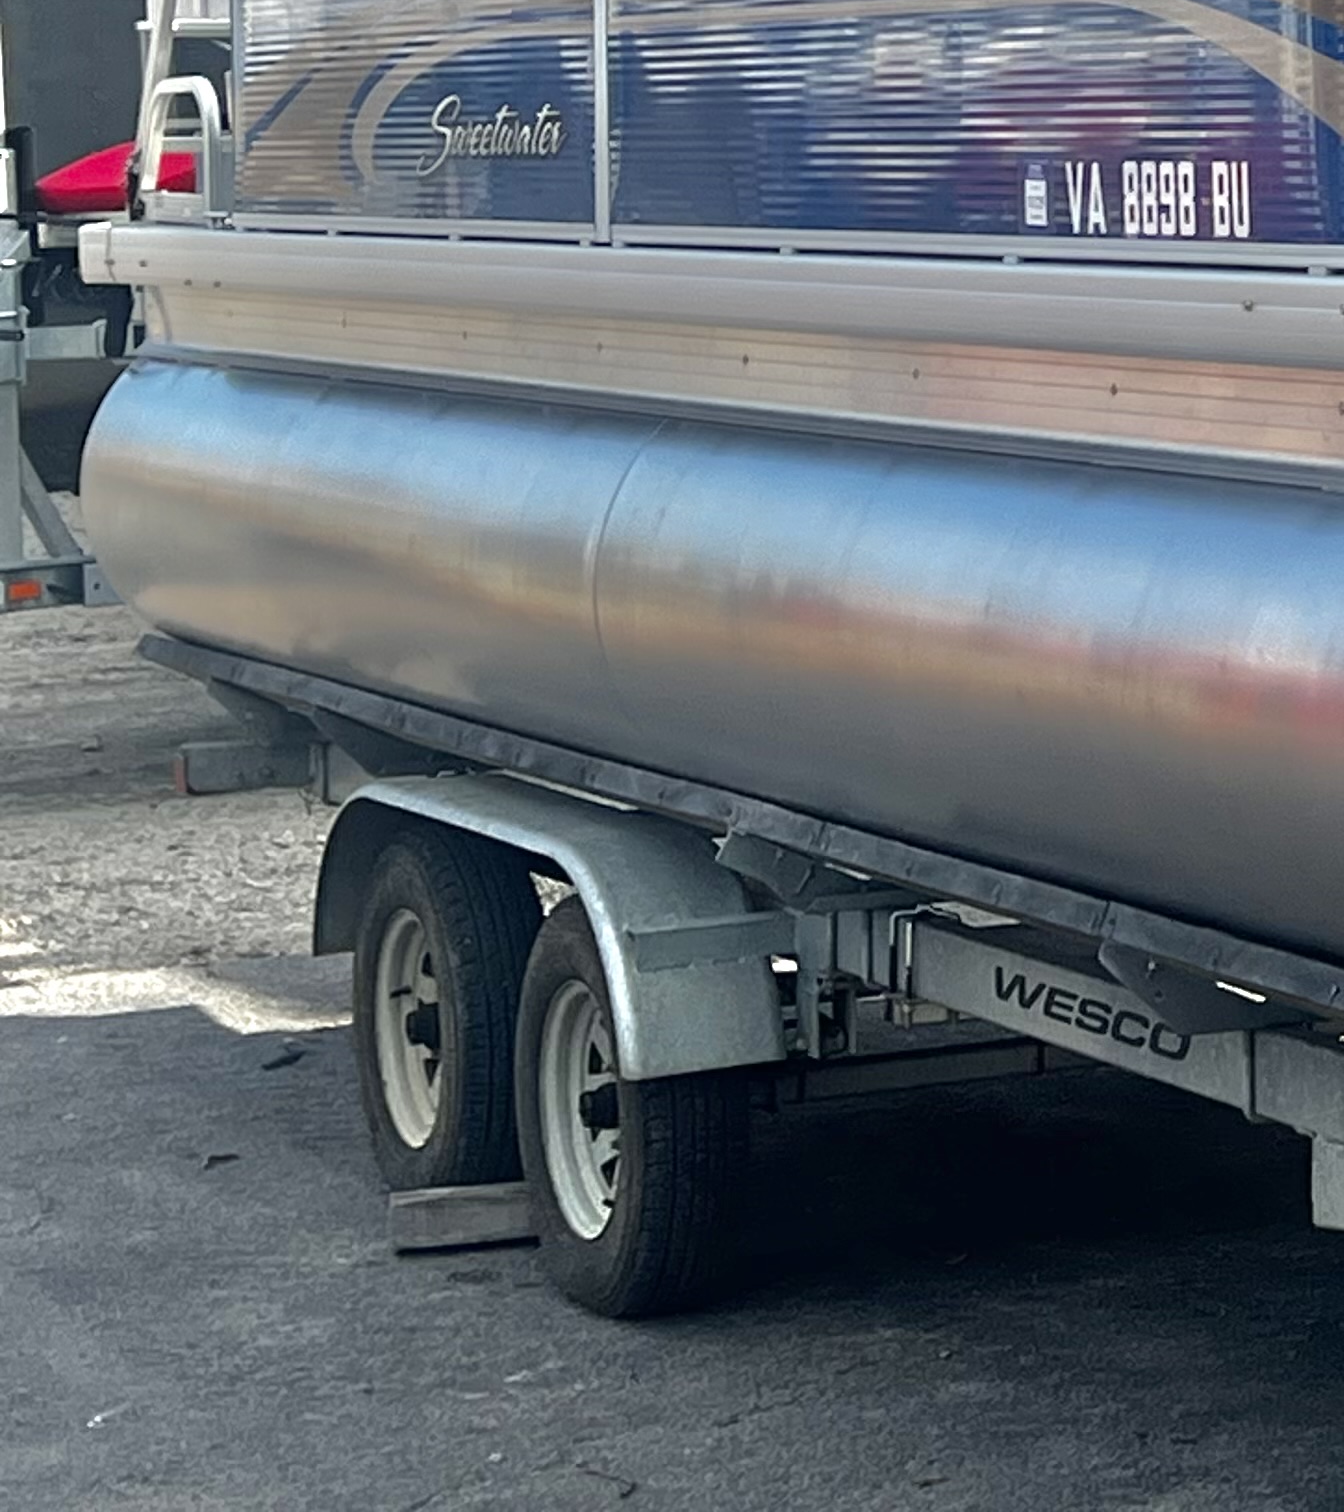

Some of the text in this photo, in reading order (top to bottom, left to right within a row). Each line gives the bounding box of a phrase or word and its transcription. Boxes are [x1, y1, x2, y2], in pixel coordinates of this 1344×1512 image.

[416, 93, 568, 177] Sweetwater
[1064, 160, 1108, 235] VA
[1122, 160, 1197, 236] 8898
[1211, 160, 1250, 238] BU
[994, 965, 1192, 1061] WESCO
